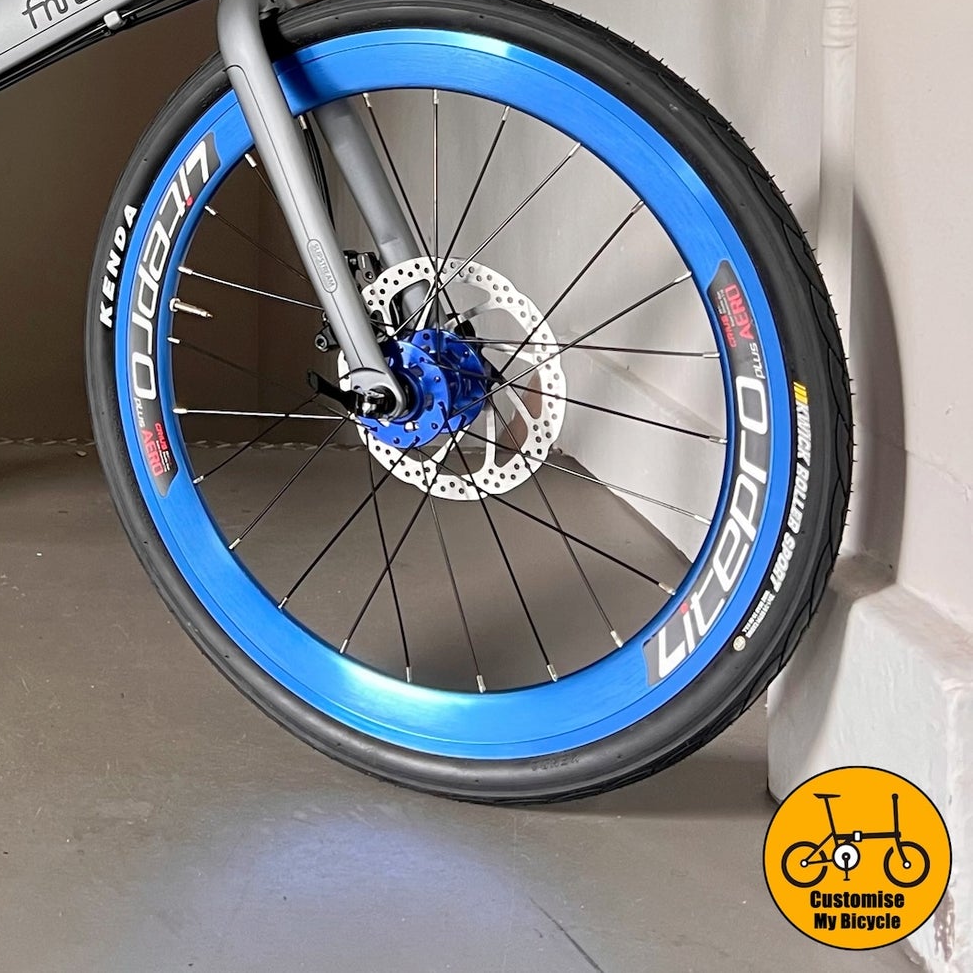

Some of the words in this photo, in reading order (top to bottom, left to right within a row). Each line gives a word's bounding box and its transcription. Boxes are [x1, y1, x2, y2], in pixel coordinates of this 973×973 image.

[98, 203, 139, 329] KENDA
[130, 140, 212, 402] Litepro
[724, 283, 755, 341] AERO
[141, 428, 165, 478] AERO
[655, 373, 769, 680] Litepro
